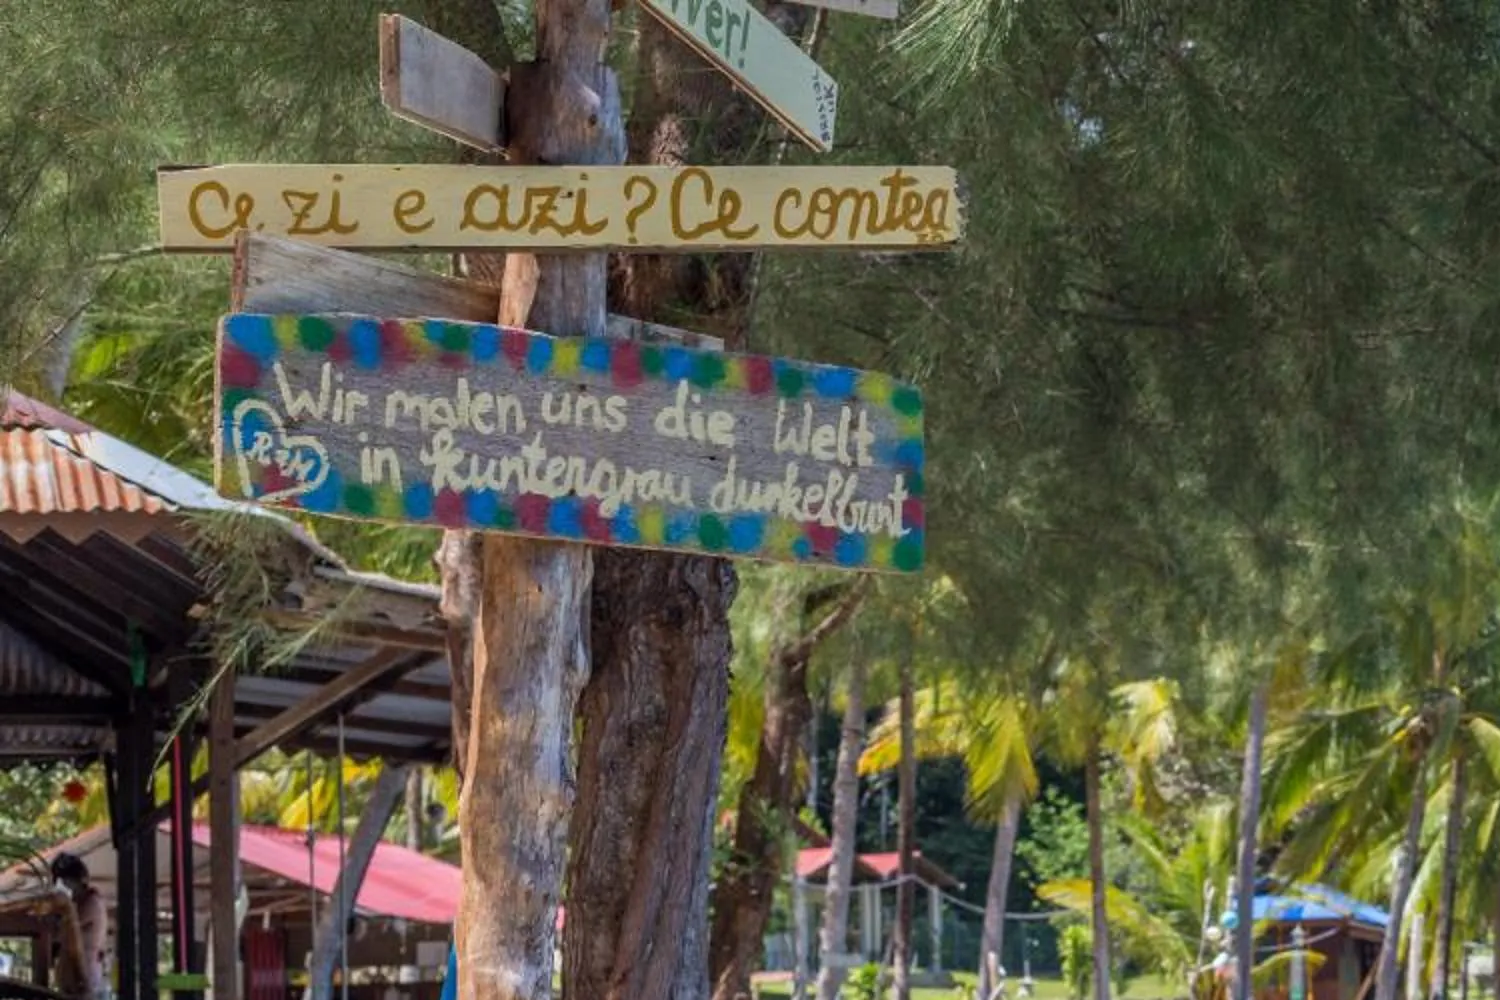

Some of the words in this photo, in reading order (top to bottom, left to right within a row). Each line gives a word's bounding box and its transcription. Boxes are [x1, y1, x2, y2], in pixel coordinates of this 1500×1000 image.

[282, 173, 359, 235] zi
[393, 189, 436, 234] e
[670, 167, 760, 241] Ce
[272, 361, 369, 425] Wir
[384, 376, 528, 435] malen
[541, 389, 628, 433] uns
[653, 377, 736, 449] die
[772, 396, 876, 467] Welt
[358, 431, 403, 493] in
